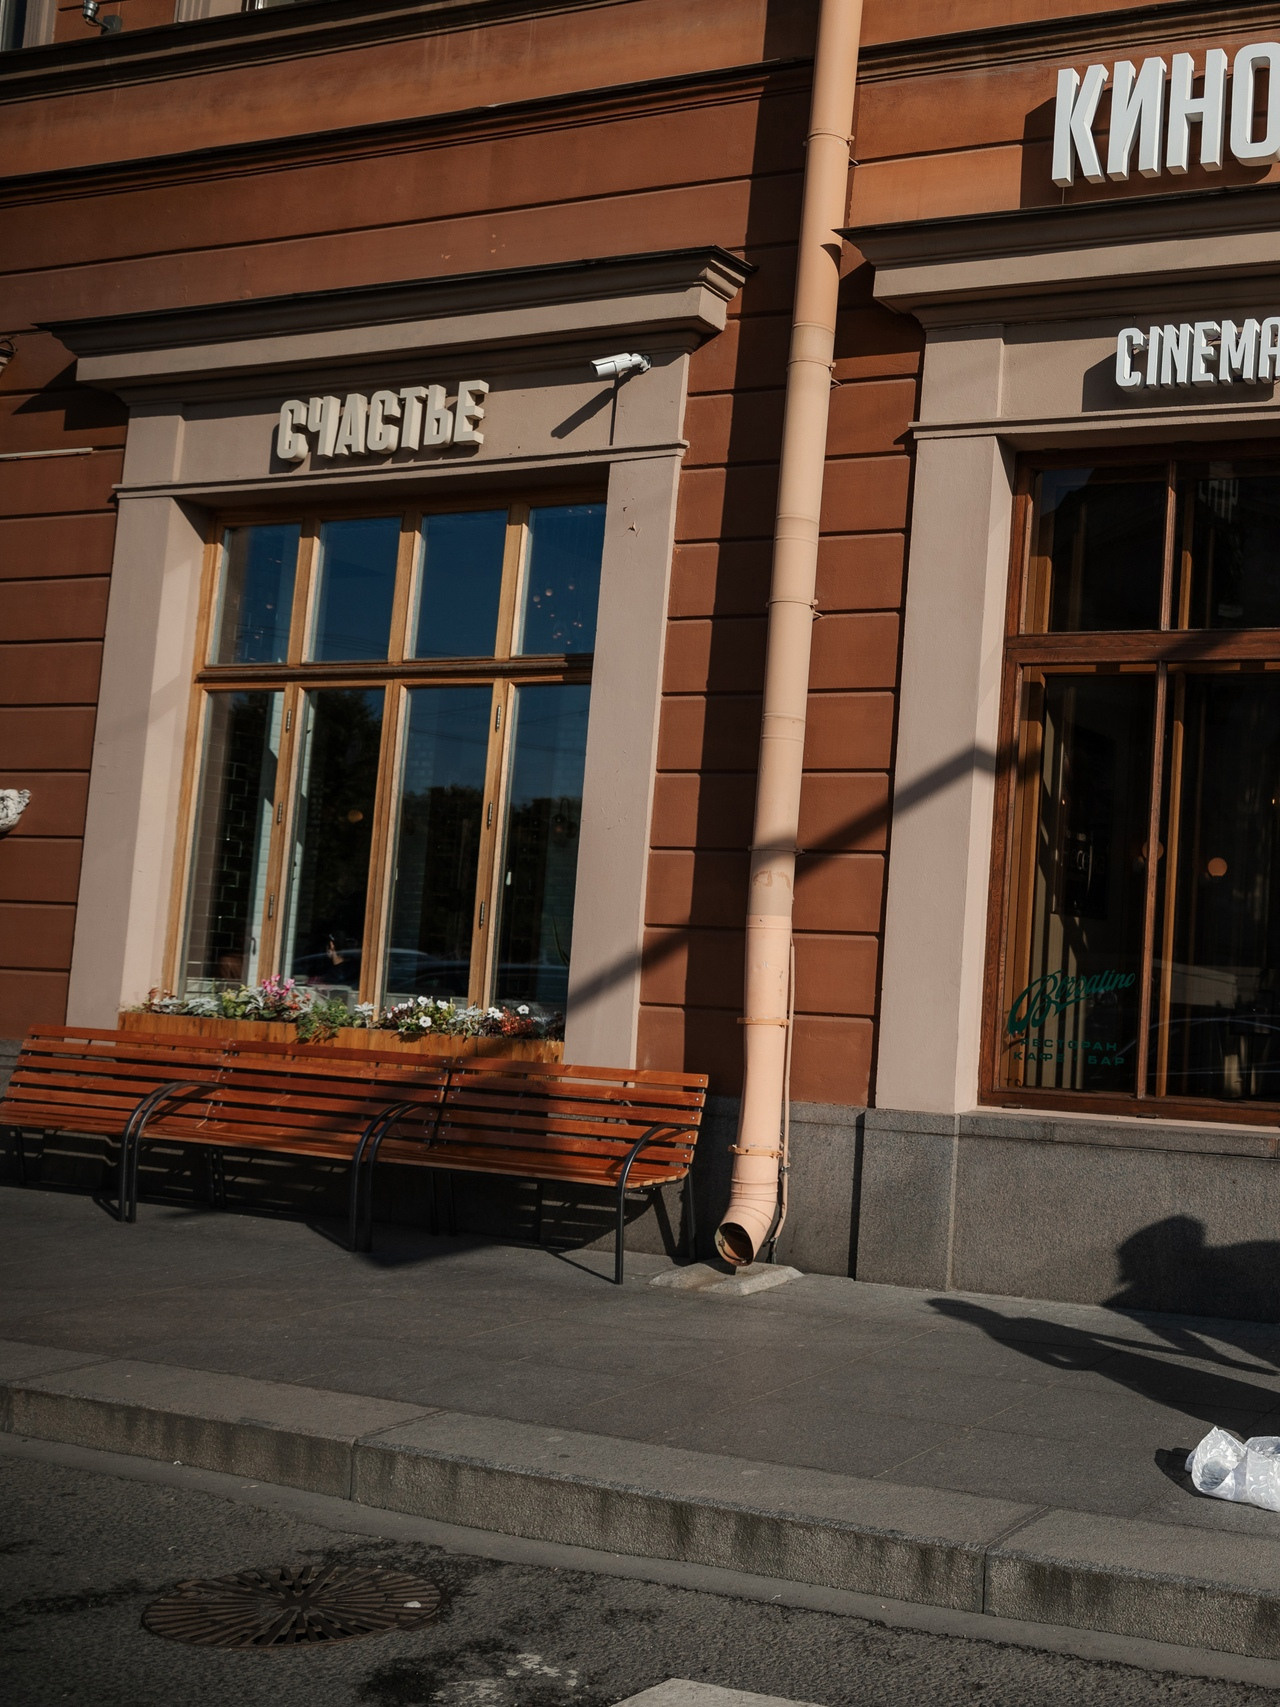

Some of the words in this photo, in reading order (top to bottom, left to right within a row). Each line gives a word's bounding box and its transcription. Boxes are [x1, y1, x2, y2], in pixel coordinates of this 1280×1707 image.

[277, 380, 490, 462] СЧАСТЬЕ
[1008, 969, 1136, 1035] Borsalino
[1014, 1053, 1065, 1063] КАФЕ
[1088, 1055, 1126, 1066] БАР
[1021, 1039, 1118, 1051] РЕСТОРАН
